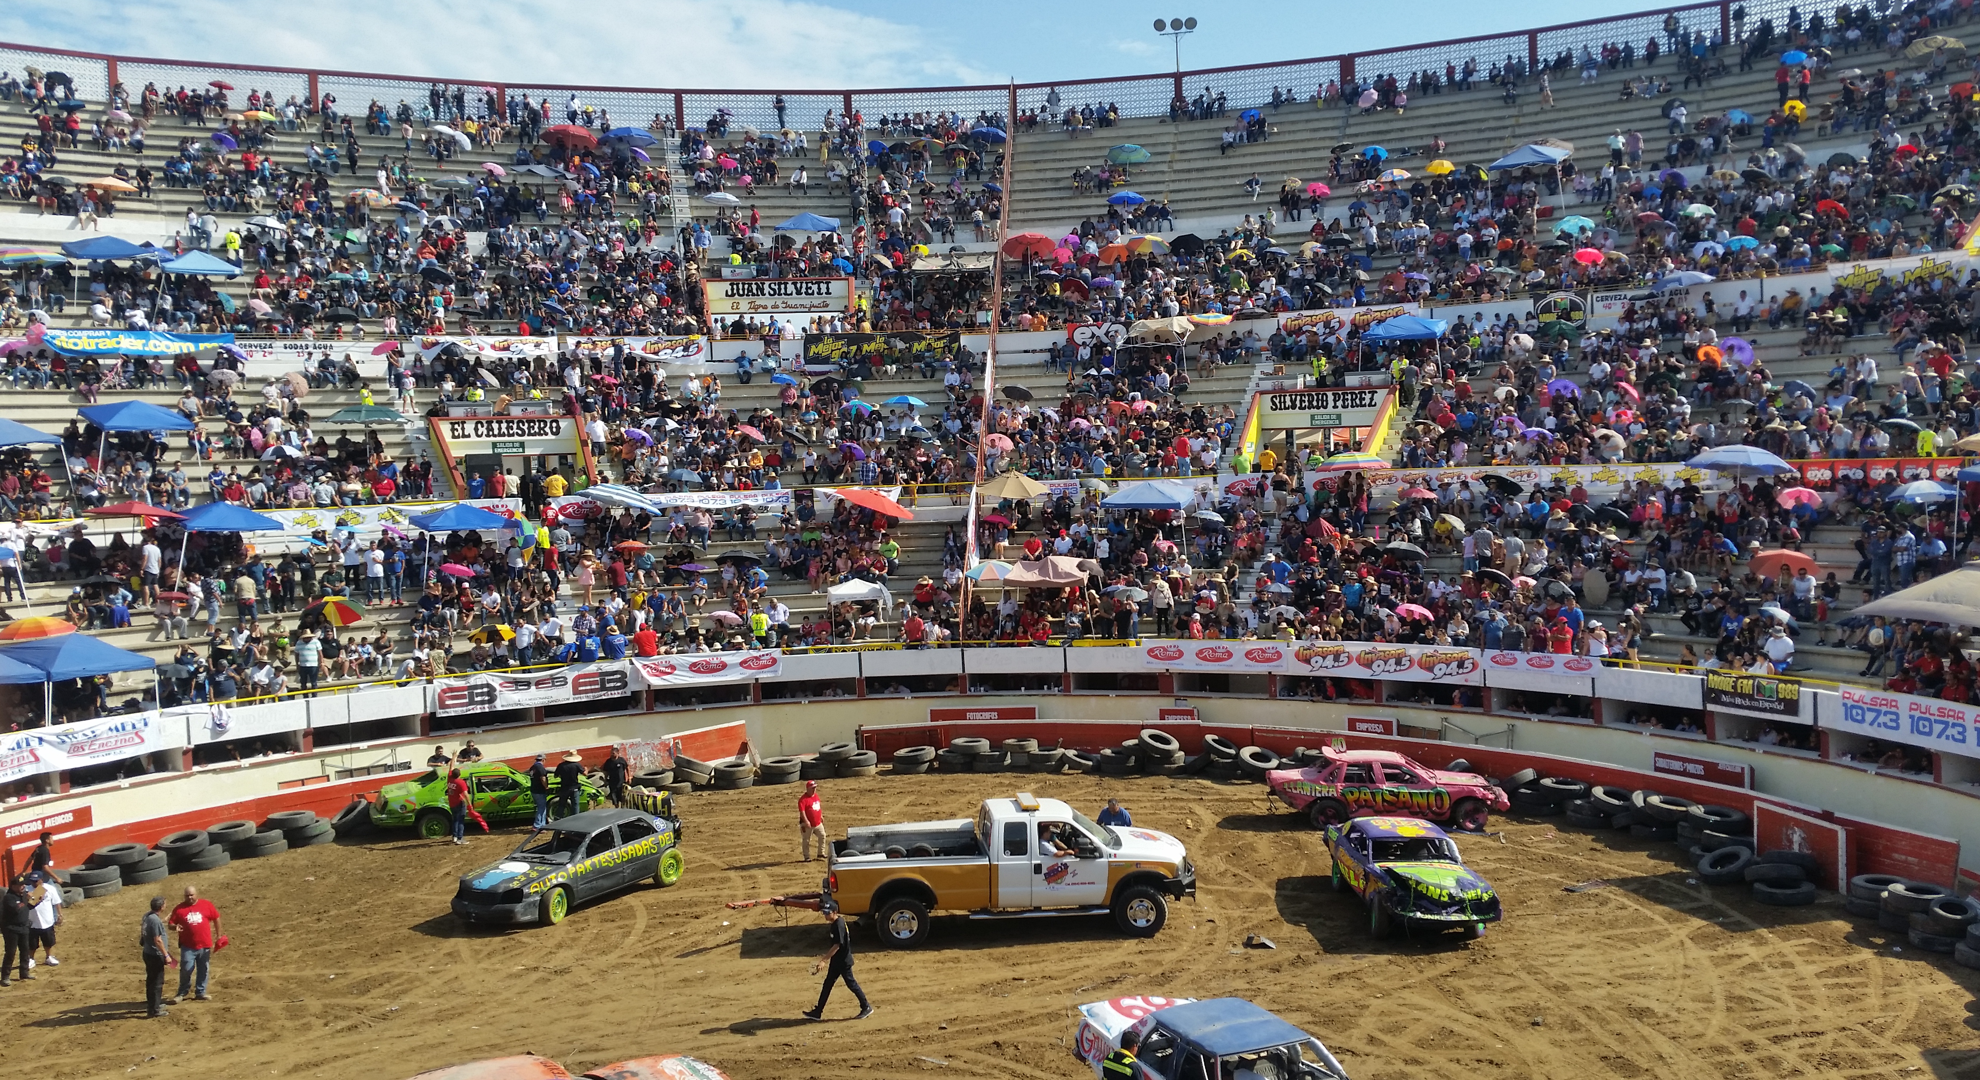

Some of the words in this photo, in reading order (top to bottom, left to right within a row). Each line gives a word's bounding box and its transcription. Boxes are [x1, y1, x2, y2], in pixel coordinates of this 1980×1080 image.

[725, 281, 768, 298] JUAN
[768, 280, 832, 297] SILVETI
[730, 301, 741, 311] El
[748, 300, 769, 312] Tigre
[1595, 293, 1628, 303] CERVEZA
[238, 342, 274, 350] CERVEZA
[283, 342, 309, 351] SODAS
[1270, 392, 1330, 411] SILVERIO
[449, 420, 471, 439] EL
[473, 419, 562, 438] CALESERO
[1150, 648, 1179, 659] Roma
[1199, 649, 1229, 660] Roma
[1248, 650, 1278, 661] Roma
[1299, 645, 1345, 659] Invasora
[1360, 648, 1407, 663] Invasora
[1421, 651, 1469, 668] Invasora
[643, 664, 672, 675] Roma
[692, 661, 723, 671] Roma
[743, 657, 773, 667] Roma
[1309, 651, 1350, 672] 94.5
[1370, 655, 1411, 677] 94.5
[1431, 658, 1474, 681] 94.5
[572, 670, 629, 696] EB
[1707, 674, 1735, 692] MORE
[1737, 678, 1753, 695] FM
[1777, 682, 1799, 700] 989
[1735, 697, 1751, 707] Rock
[1758, 698, 1785, 711] Español
[1842, 690, 1900, 710] PULSAR
[1909, 702, 1966, 723] PULSAR
[1356, 722, 1384, 733] EMPRESA
[1842, 702, 1900, 731] 107.3
[1909, 714, 1967, 744] 107.3
[1332, 737, 1347, 752] 40
[1284, 782, 1338, 798] LLANTERA
[1342, 786, 1450, 817] PAISANO
[5, 820, 43, 838] SERVICIOS
[44, 812, 74, 828] MEDICOS
[530, 870, 568, 895] AUTO
[568, 852, 614, 880] PARTES
[614, 837, 658, 863] USADAS
